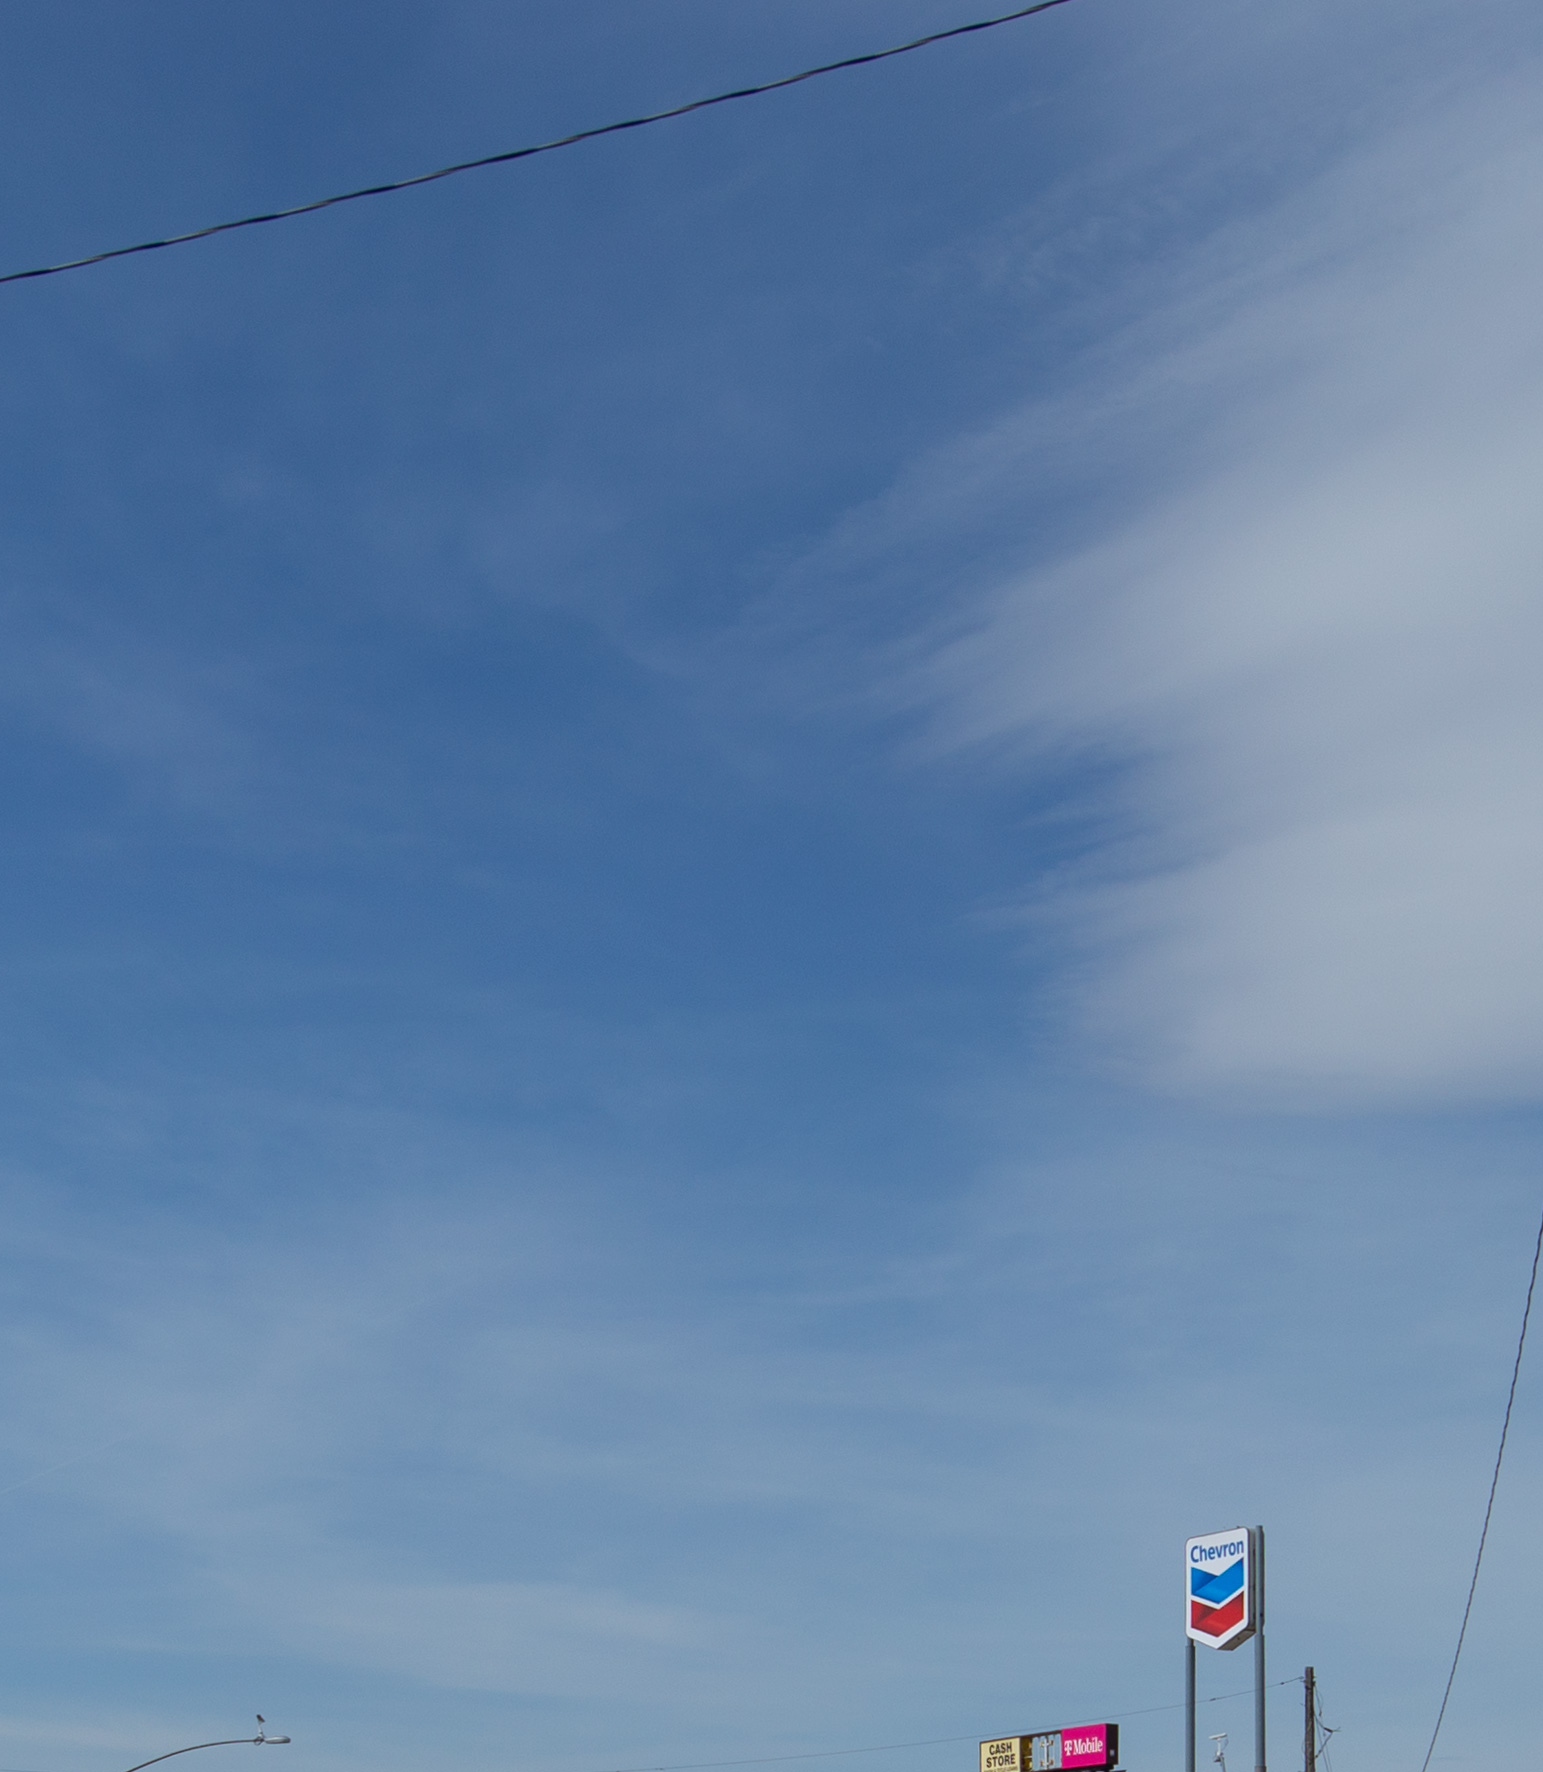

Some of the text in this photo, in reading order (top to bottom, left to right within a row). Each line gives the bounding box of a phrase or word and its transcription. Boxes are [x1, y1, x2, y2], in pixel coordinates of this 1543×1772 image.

[1191, 1541, 1244, 1563] Chevron
[989, 1742, 1013, 1756] CASH
[986, 1754, 1016, 1769] STORE
